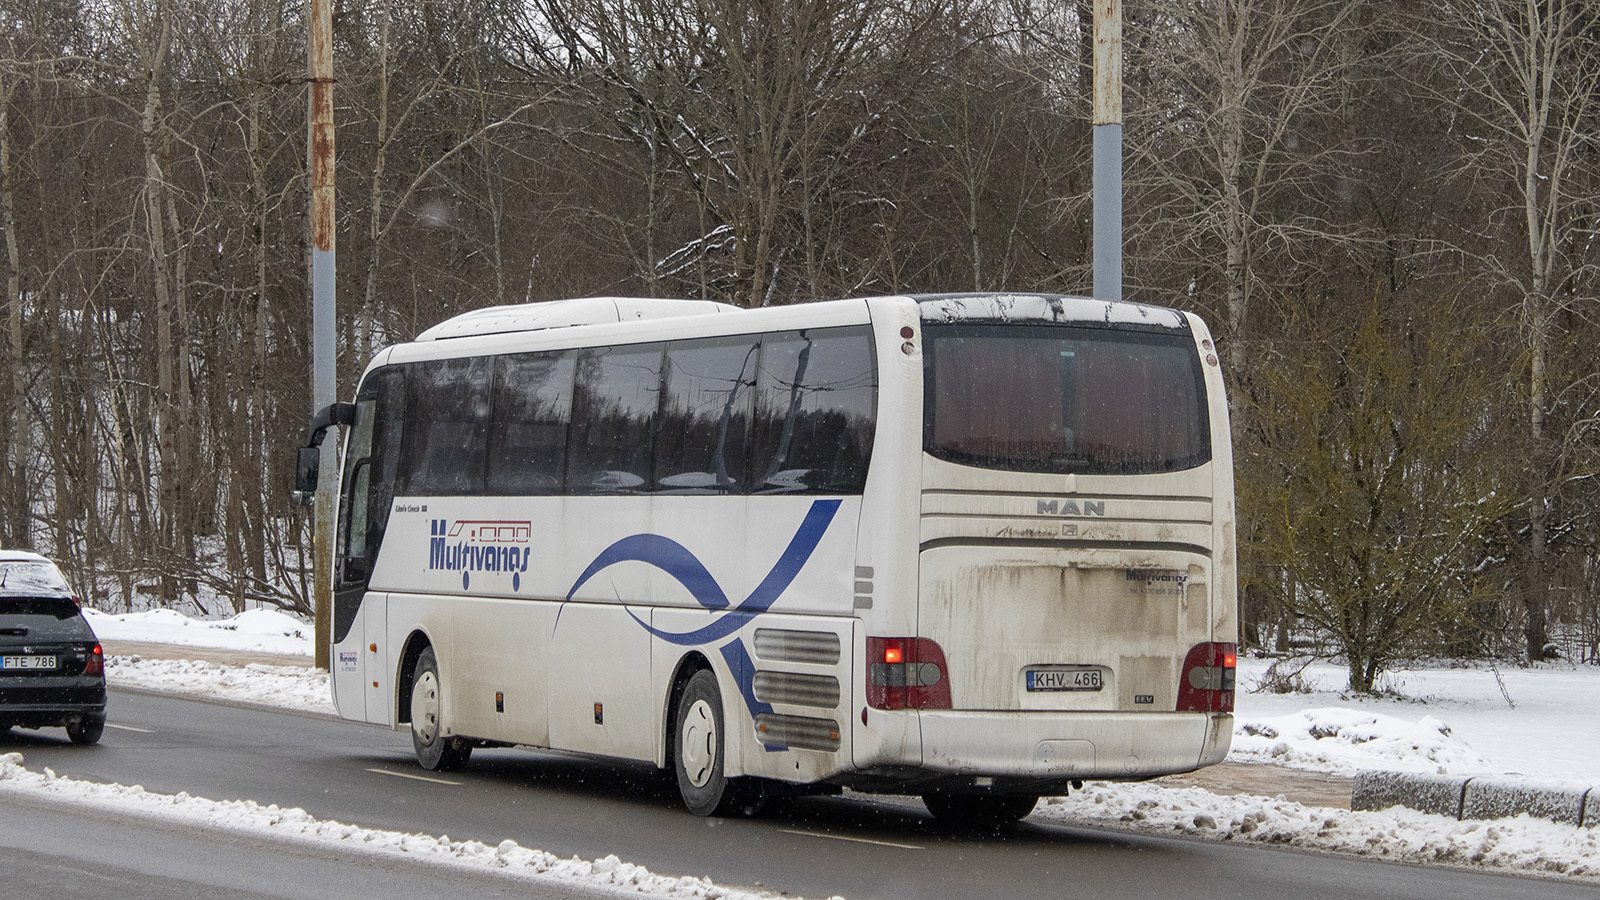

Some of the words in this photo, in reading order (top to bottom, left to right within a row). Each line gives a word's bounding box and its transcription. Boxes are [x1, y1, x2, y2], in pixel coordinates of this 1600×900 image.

[1037, 499, 1105, 516] MAN
[4, 657, 28, 668] FTE
[35, 657, 55, 668] 786
[1035, 673, 1065, 687] KHV
[1074, 672, 1099, 687] 466
